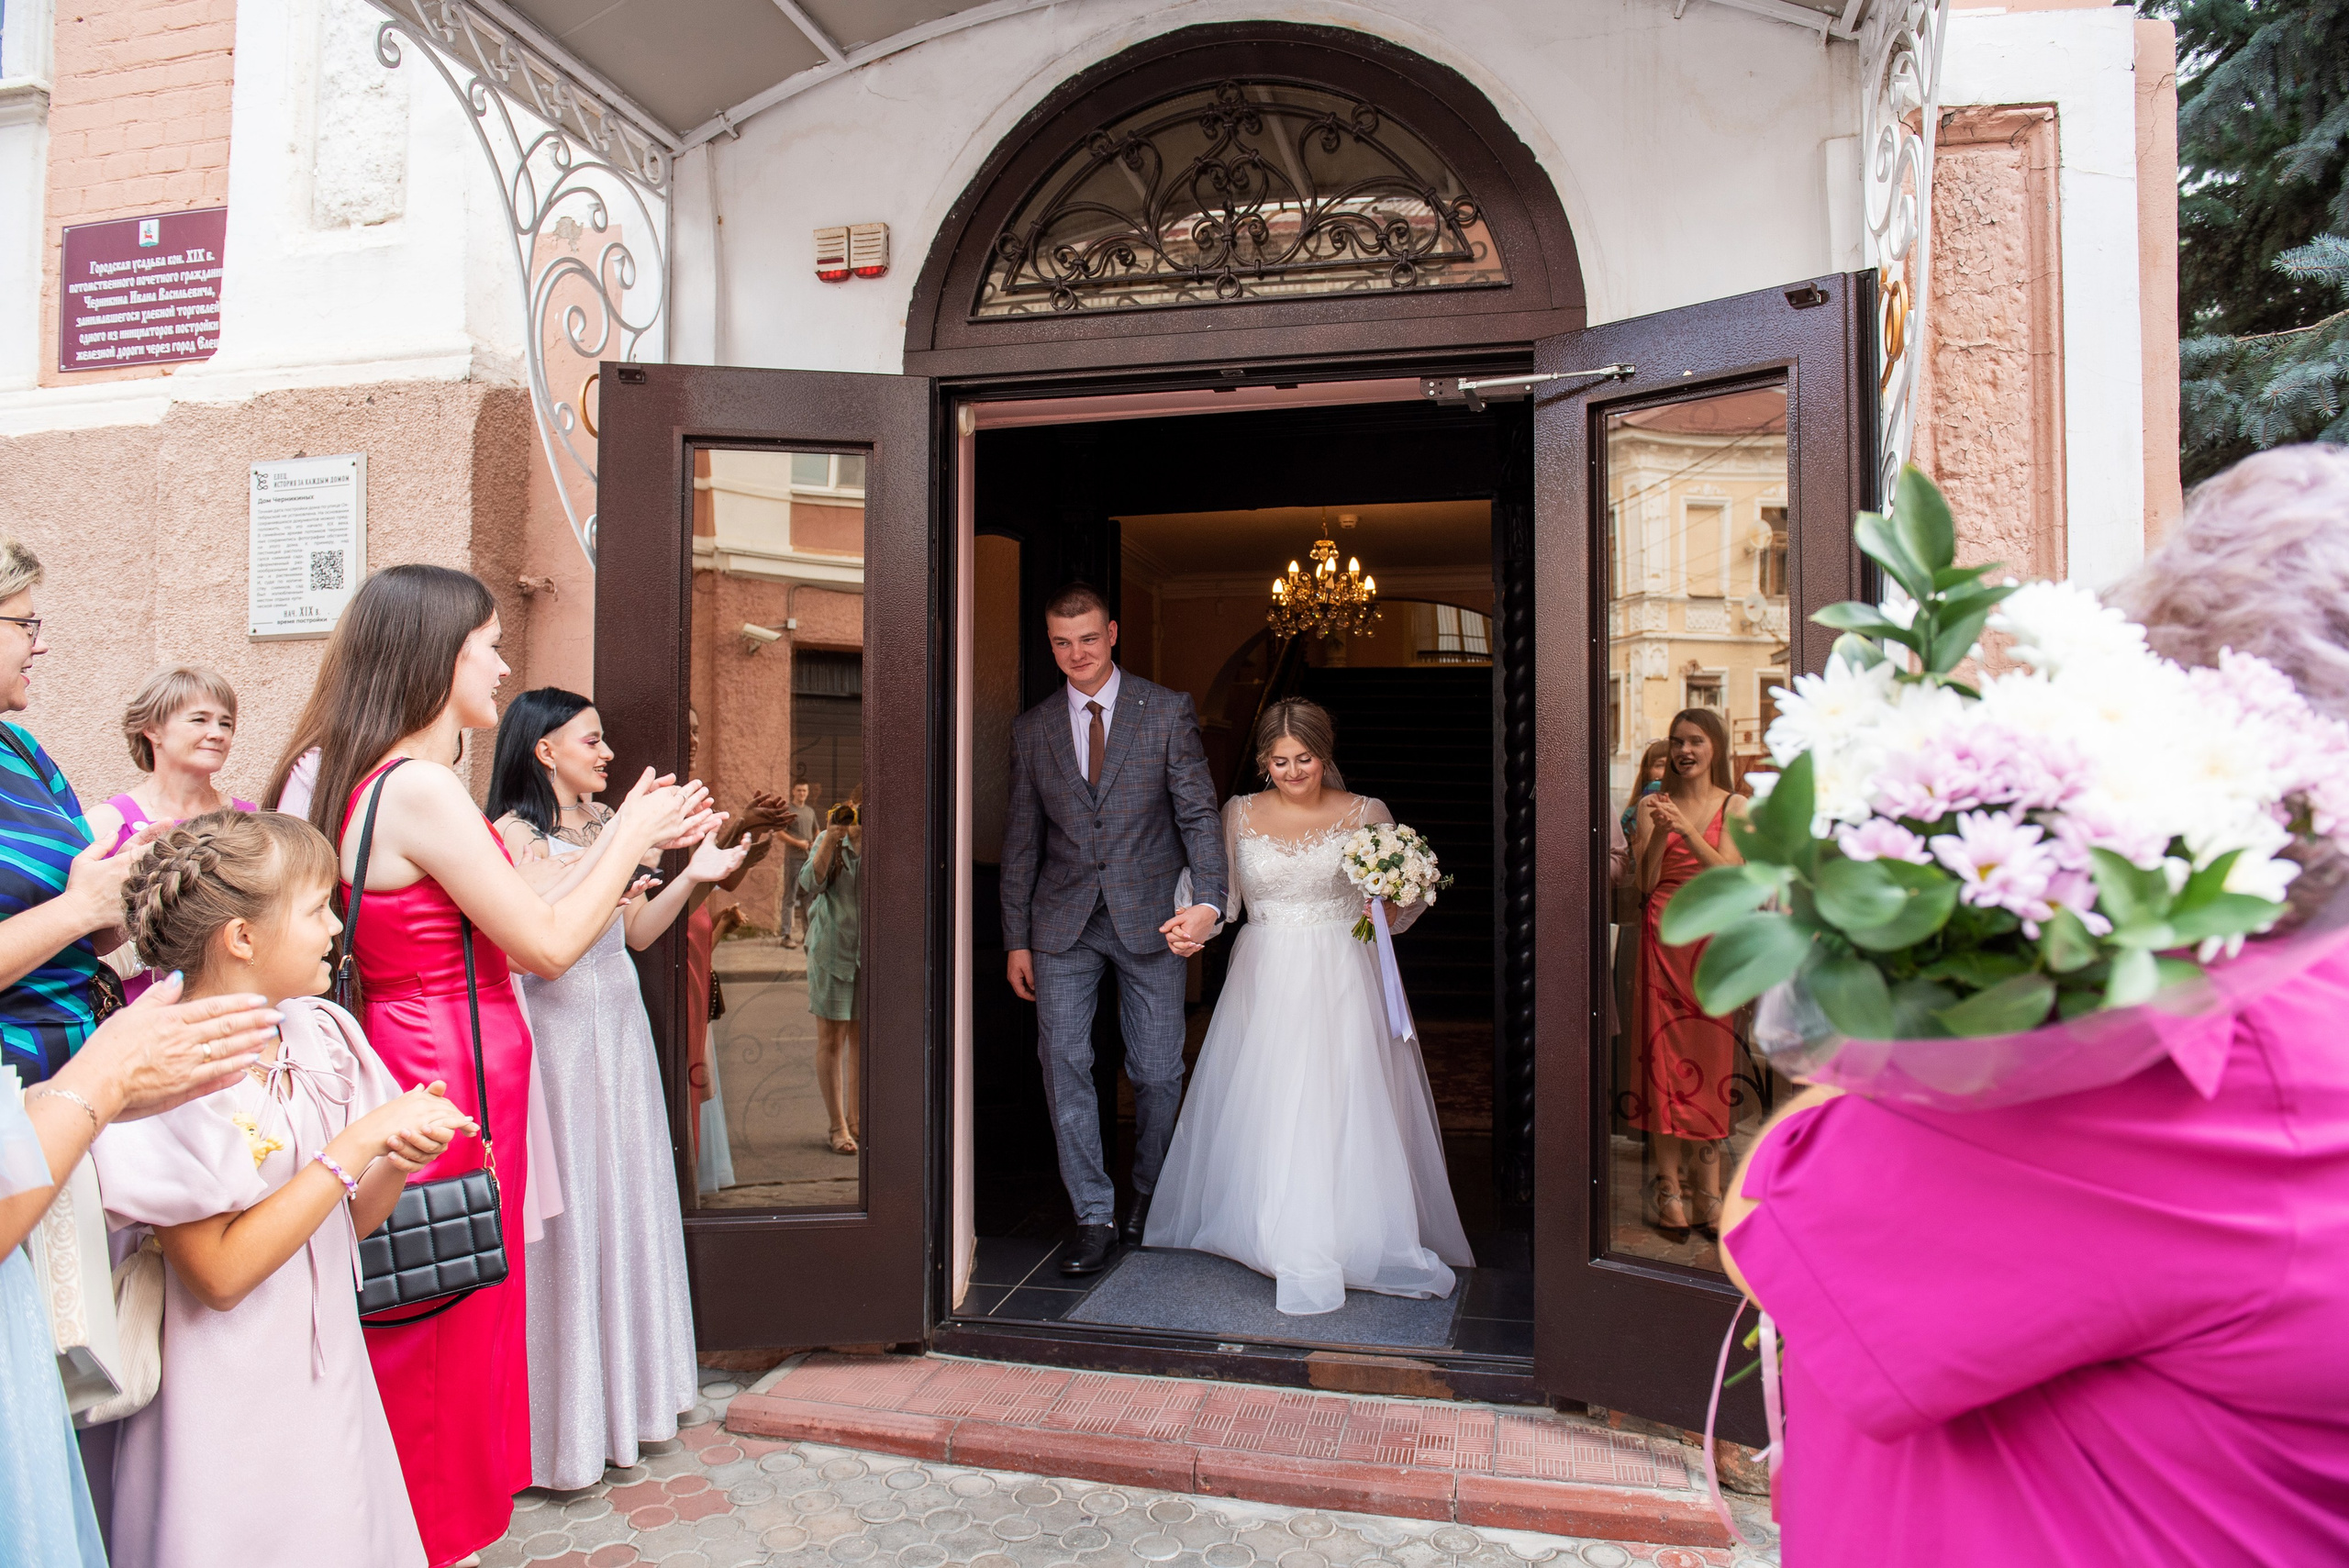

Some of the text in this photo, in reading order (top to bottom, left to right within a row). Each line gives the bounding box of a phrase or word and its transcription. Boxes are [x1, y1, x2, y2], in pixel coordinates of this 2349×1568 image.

[89, 248, 215, 276] Городская усадьба кон. XIX в.
[69, 277, 135, 293] потомственного
[136, 272, 179, 285] почетного
[83, 286, 215, 311] Черникина Ивана Васильевича,
[75, 311, 139, 327] занимавшегося
[140, 305, 174, 323] хлебной
[79, 318, 218, 345] одного из инициаторов постройки
[75, 345, 115, 361] железной
[116, 345, 144, 359] дороги
[145, 342, 170, 357] через
[172, 340, 195, 354] город
[299, 606, 313, 617] XIX
